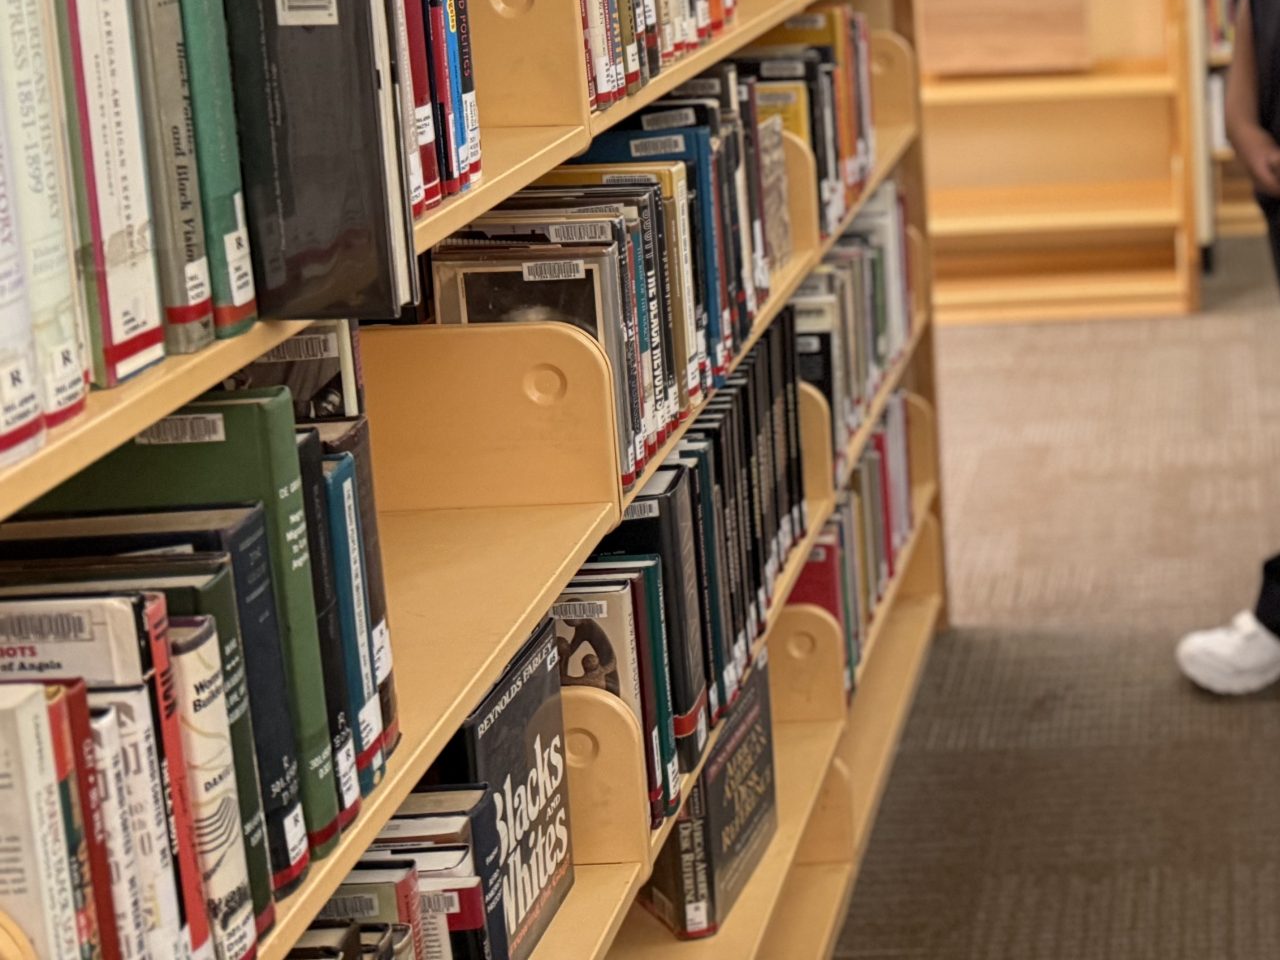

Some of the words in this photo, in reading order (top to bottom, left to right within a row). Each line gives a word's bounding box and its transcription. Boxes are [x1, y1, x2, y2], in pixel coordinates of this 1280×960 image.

[460, 15, 470, 77] POLITICS
[16, 78, 44, 194] 1851-1899
[170, 125, 186, 157] and
[37, 110, 62, 221] HISTORY
[175, 164, 194, 211] Black
[641, 209, 654, 259] SCOTT
[646, 270, 657, 298] THE
[648, 300, 662, 346] BLACK
[651, 347, 666, 410] REVOLTS
[477, 676, 523, 740] REYNOLDS
[521, 640, 553, 685] FARLEY
[545, 793, 562, 821] AND
[679, 822, 691, 852] DESK
[502, 806, 568, 936] Whites
